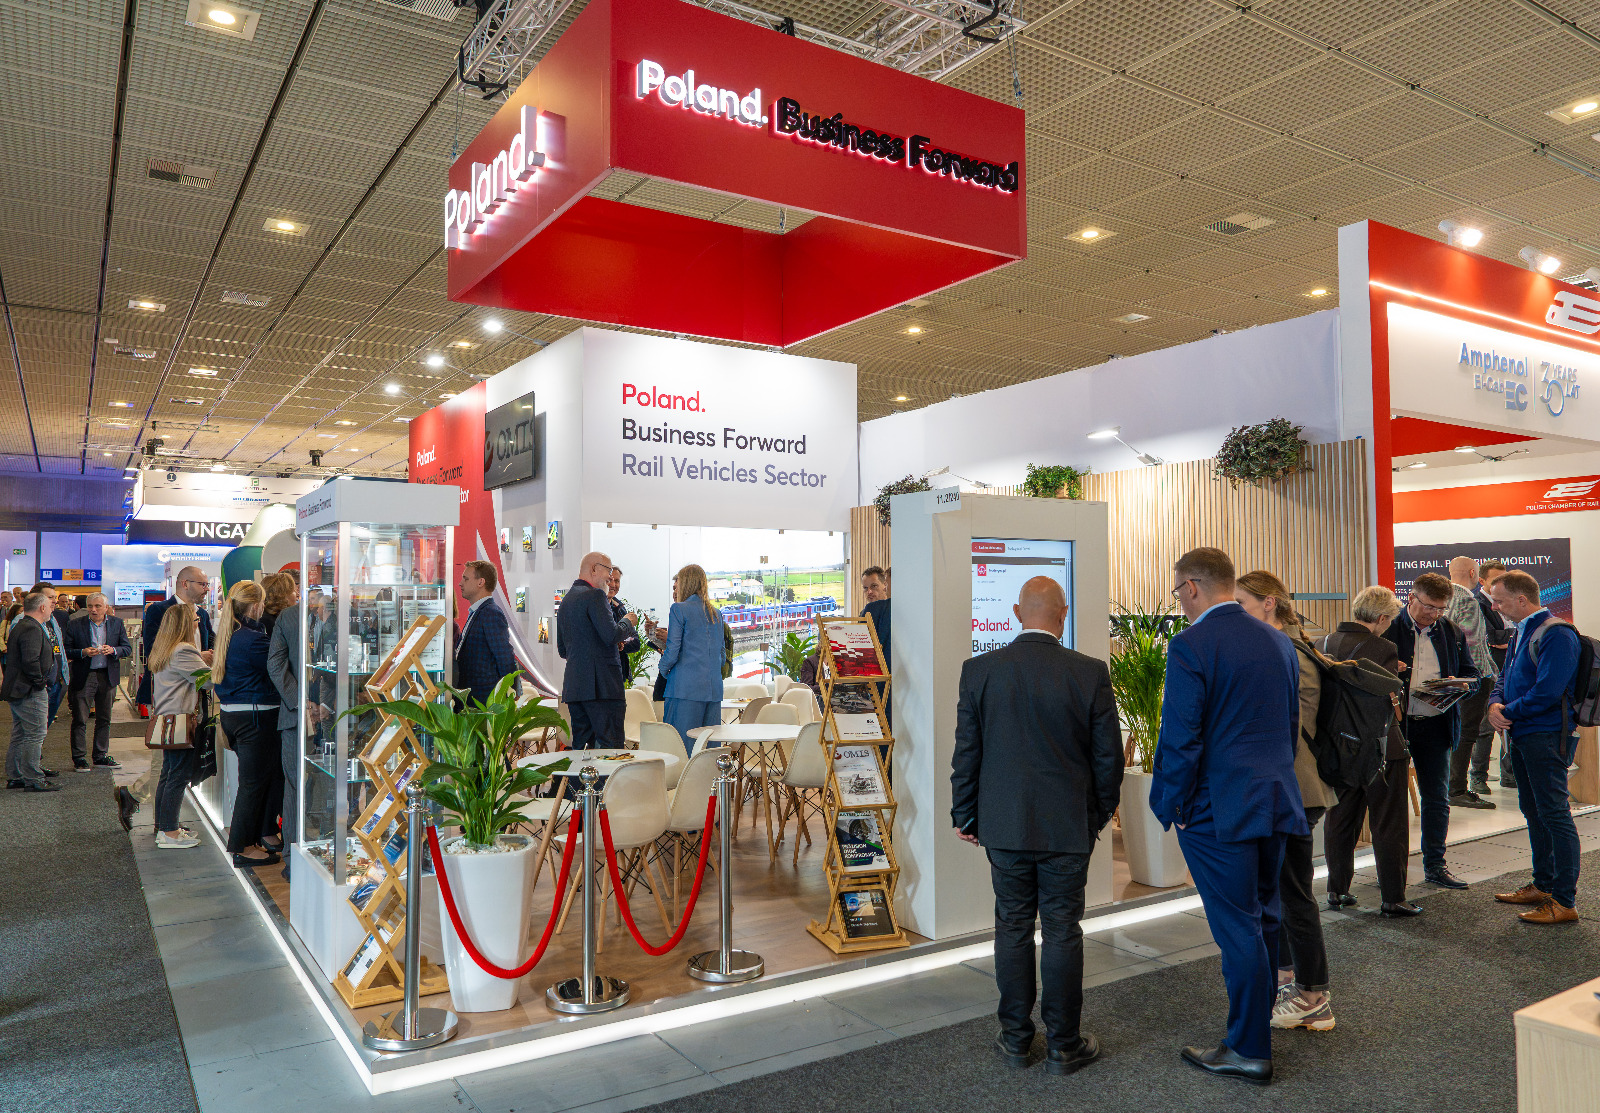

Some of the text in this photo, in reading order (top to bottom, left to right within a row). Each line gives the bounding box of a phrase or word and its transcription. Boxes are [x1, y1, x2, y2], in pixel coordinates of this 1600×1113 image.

[637, 59, 1018, 193] Poland. Business Forward
[445, 105, 545, 249] Poland.
[1459, 342, 1528, 377] Amphenol
[1552, 364, 1577, 382] YEARS
[1474, 374, 1505, 393] El-Cab
[1565, 383, 1580, 399] LAT
[622, 383, 706, 412] Poland.
[622, 418, 807, 454] Business Forward
[417, 445, 436, 467] Poland.
[622, 453, 827, 488] Rail Vehicles Sector
[460, 488, 469, 503] tor
[184, 522, 252, 539] UNGA
[1394, 561, 1418, 569] TING
[1420, 559, 1443, 568] RAIL.
[1501, 555, 1553, 566] MOBILITY.
[86, 571, 97, 579] 18
[971, 617, 1013, 631] Poland.
[972, 638, 1012, 653] Busine
[843, 750, 870, 759] OMIS
